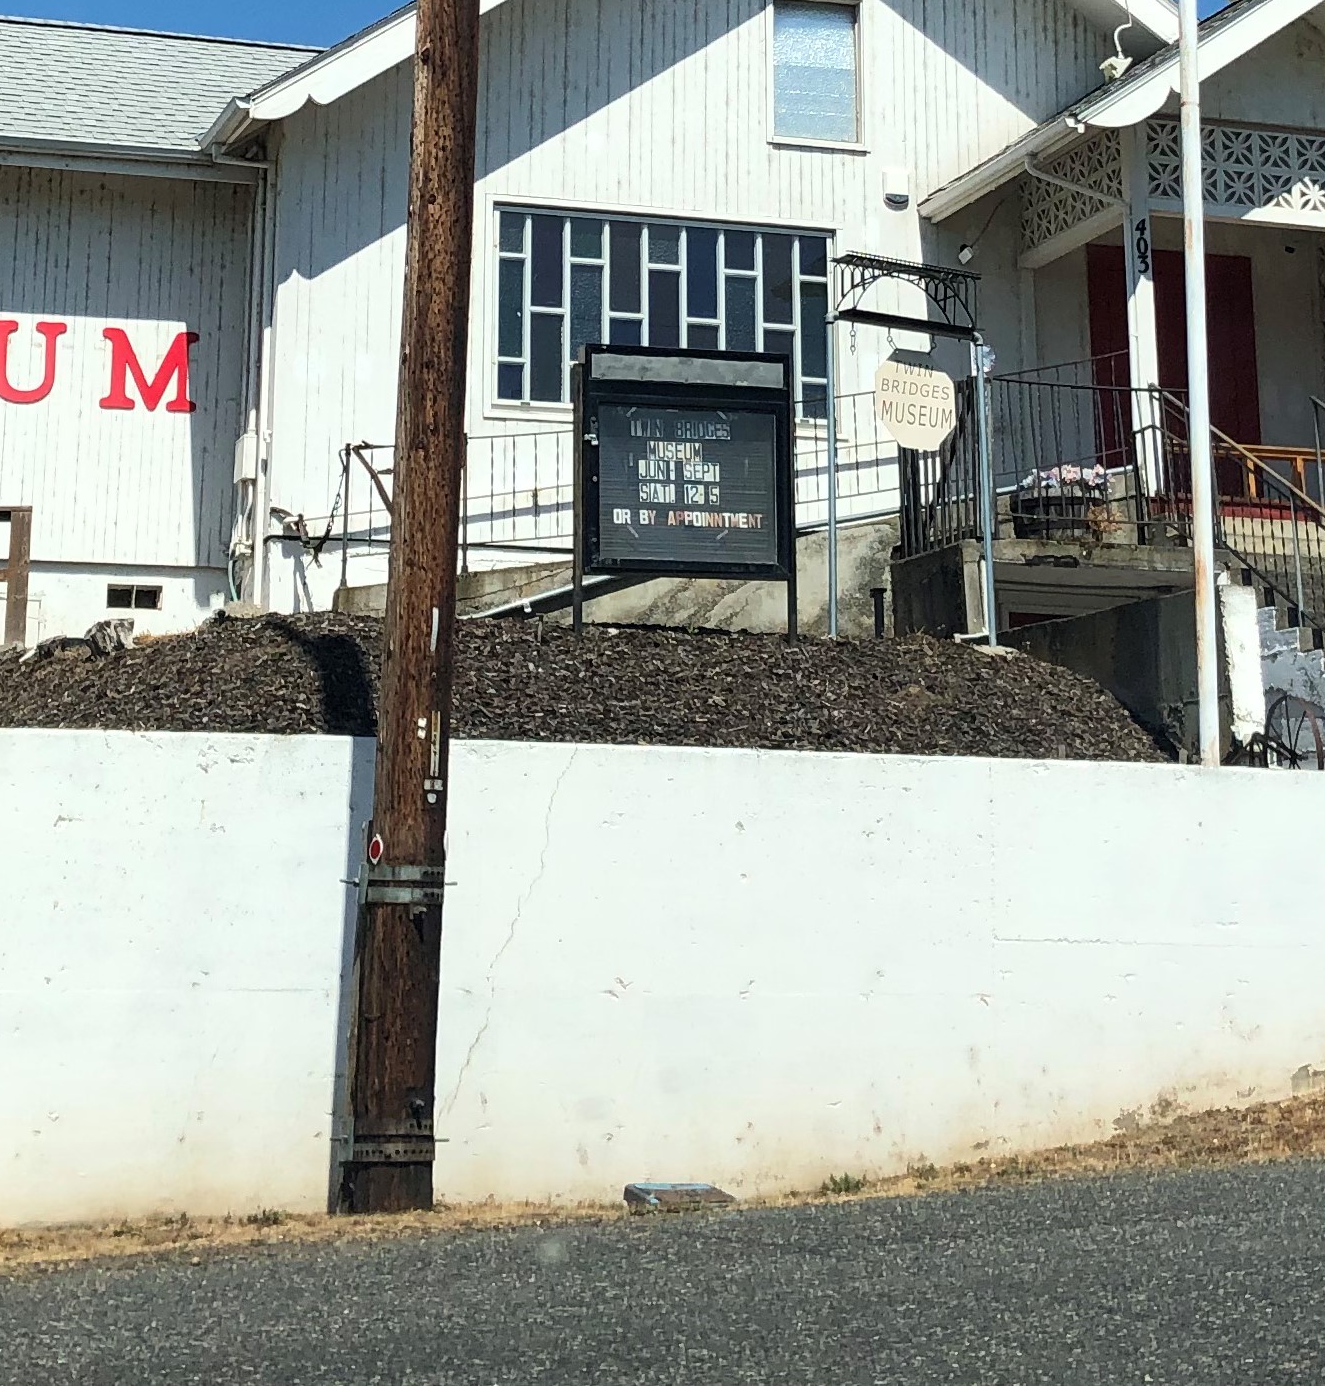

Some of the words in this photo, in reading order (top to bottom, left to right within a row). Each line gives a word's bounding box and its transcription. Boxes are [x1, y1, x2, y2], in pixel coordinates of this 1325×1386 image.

[1135, 218, 1150, 274] 403
[894, 360, 934, 379] TWIN
[881, 377, 950, 401] BRIDGES
[881, 399, 953, 430] MUSEUM
[676, 421, 731, 439] BRIDGES
[647, 441, 702, 462] MUSEUM
[683, 462, 720, 482] SEPT
[639, 483, 675, 503] SAT.
[613, 508, 631, 525] OR
[639, 509, 657, 525] BY
